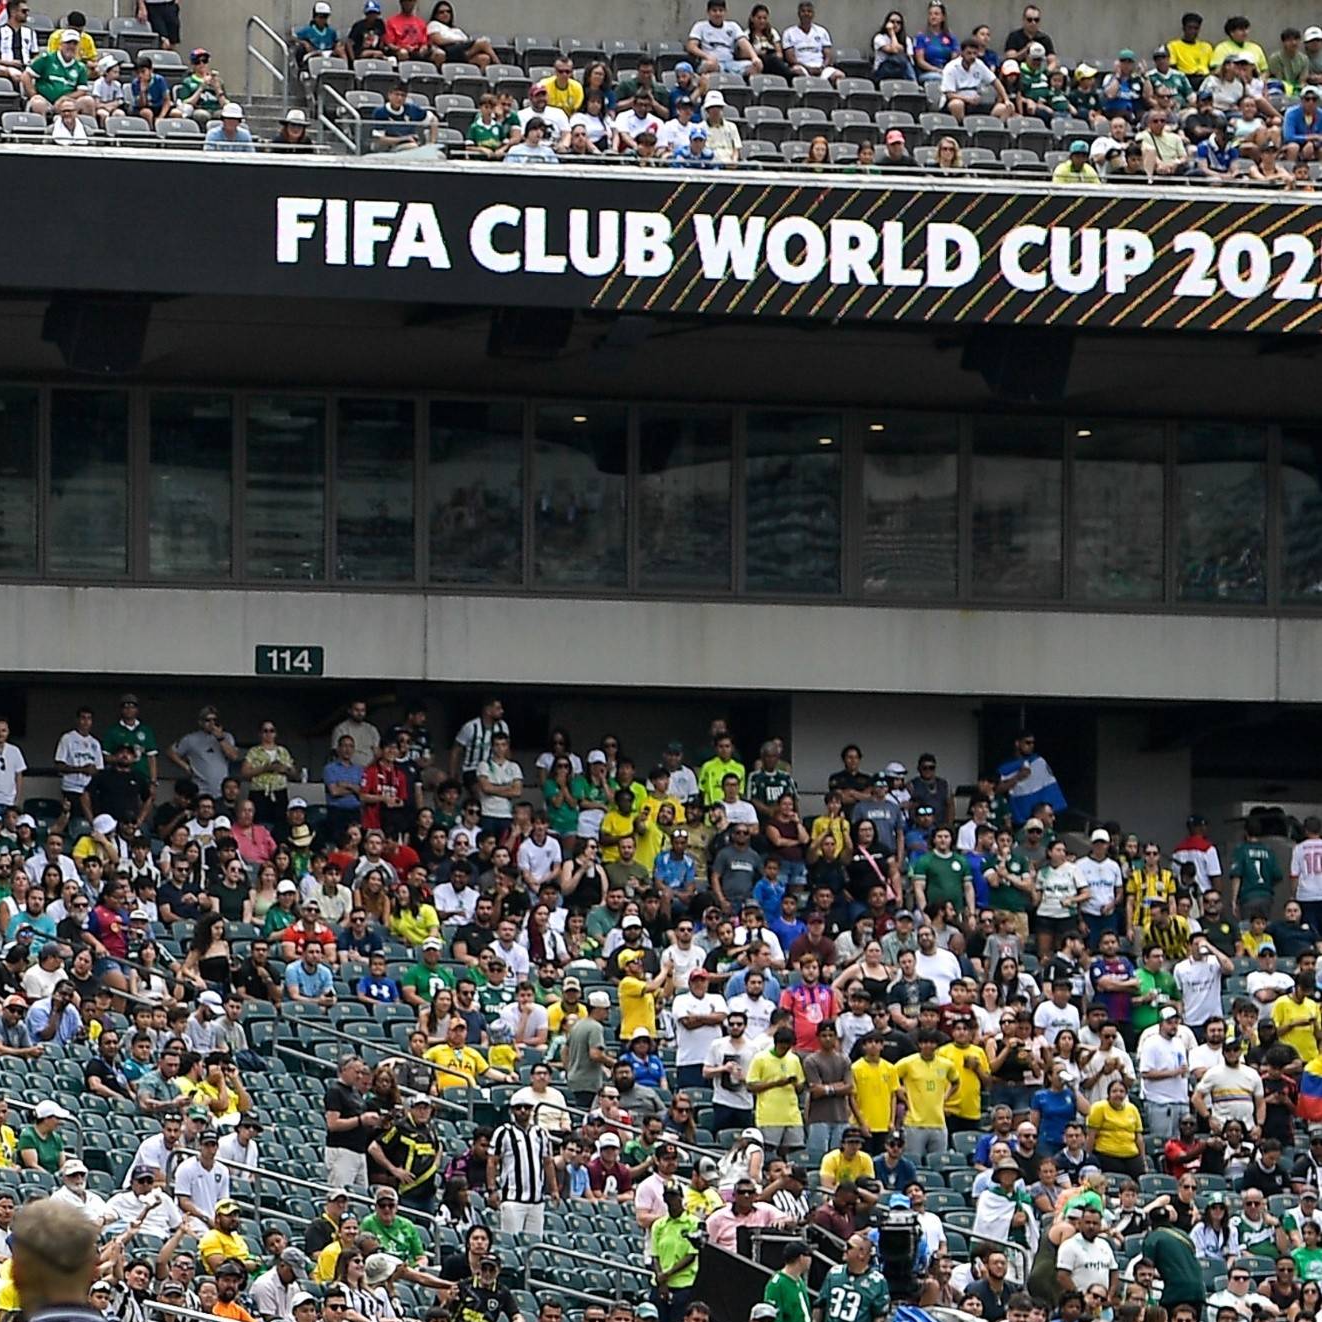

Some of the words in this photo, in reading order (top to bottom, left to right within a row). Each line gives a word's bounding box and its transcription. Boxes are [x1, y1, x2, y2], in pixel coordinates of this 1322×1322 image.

[276, 196, 452, 269] FIFA
[469, 203, 675, 277] CLUB
[693, 213, 981, 289] WORLD
[999, 223, 1155, 294] CUP
[1173, 230, 1322, 300] 202
[267, 649, 312, 673] 114
[829, 1286, 863, 1322] 33
